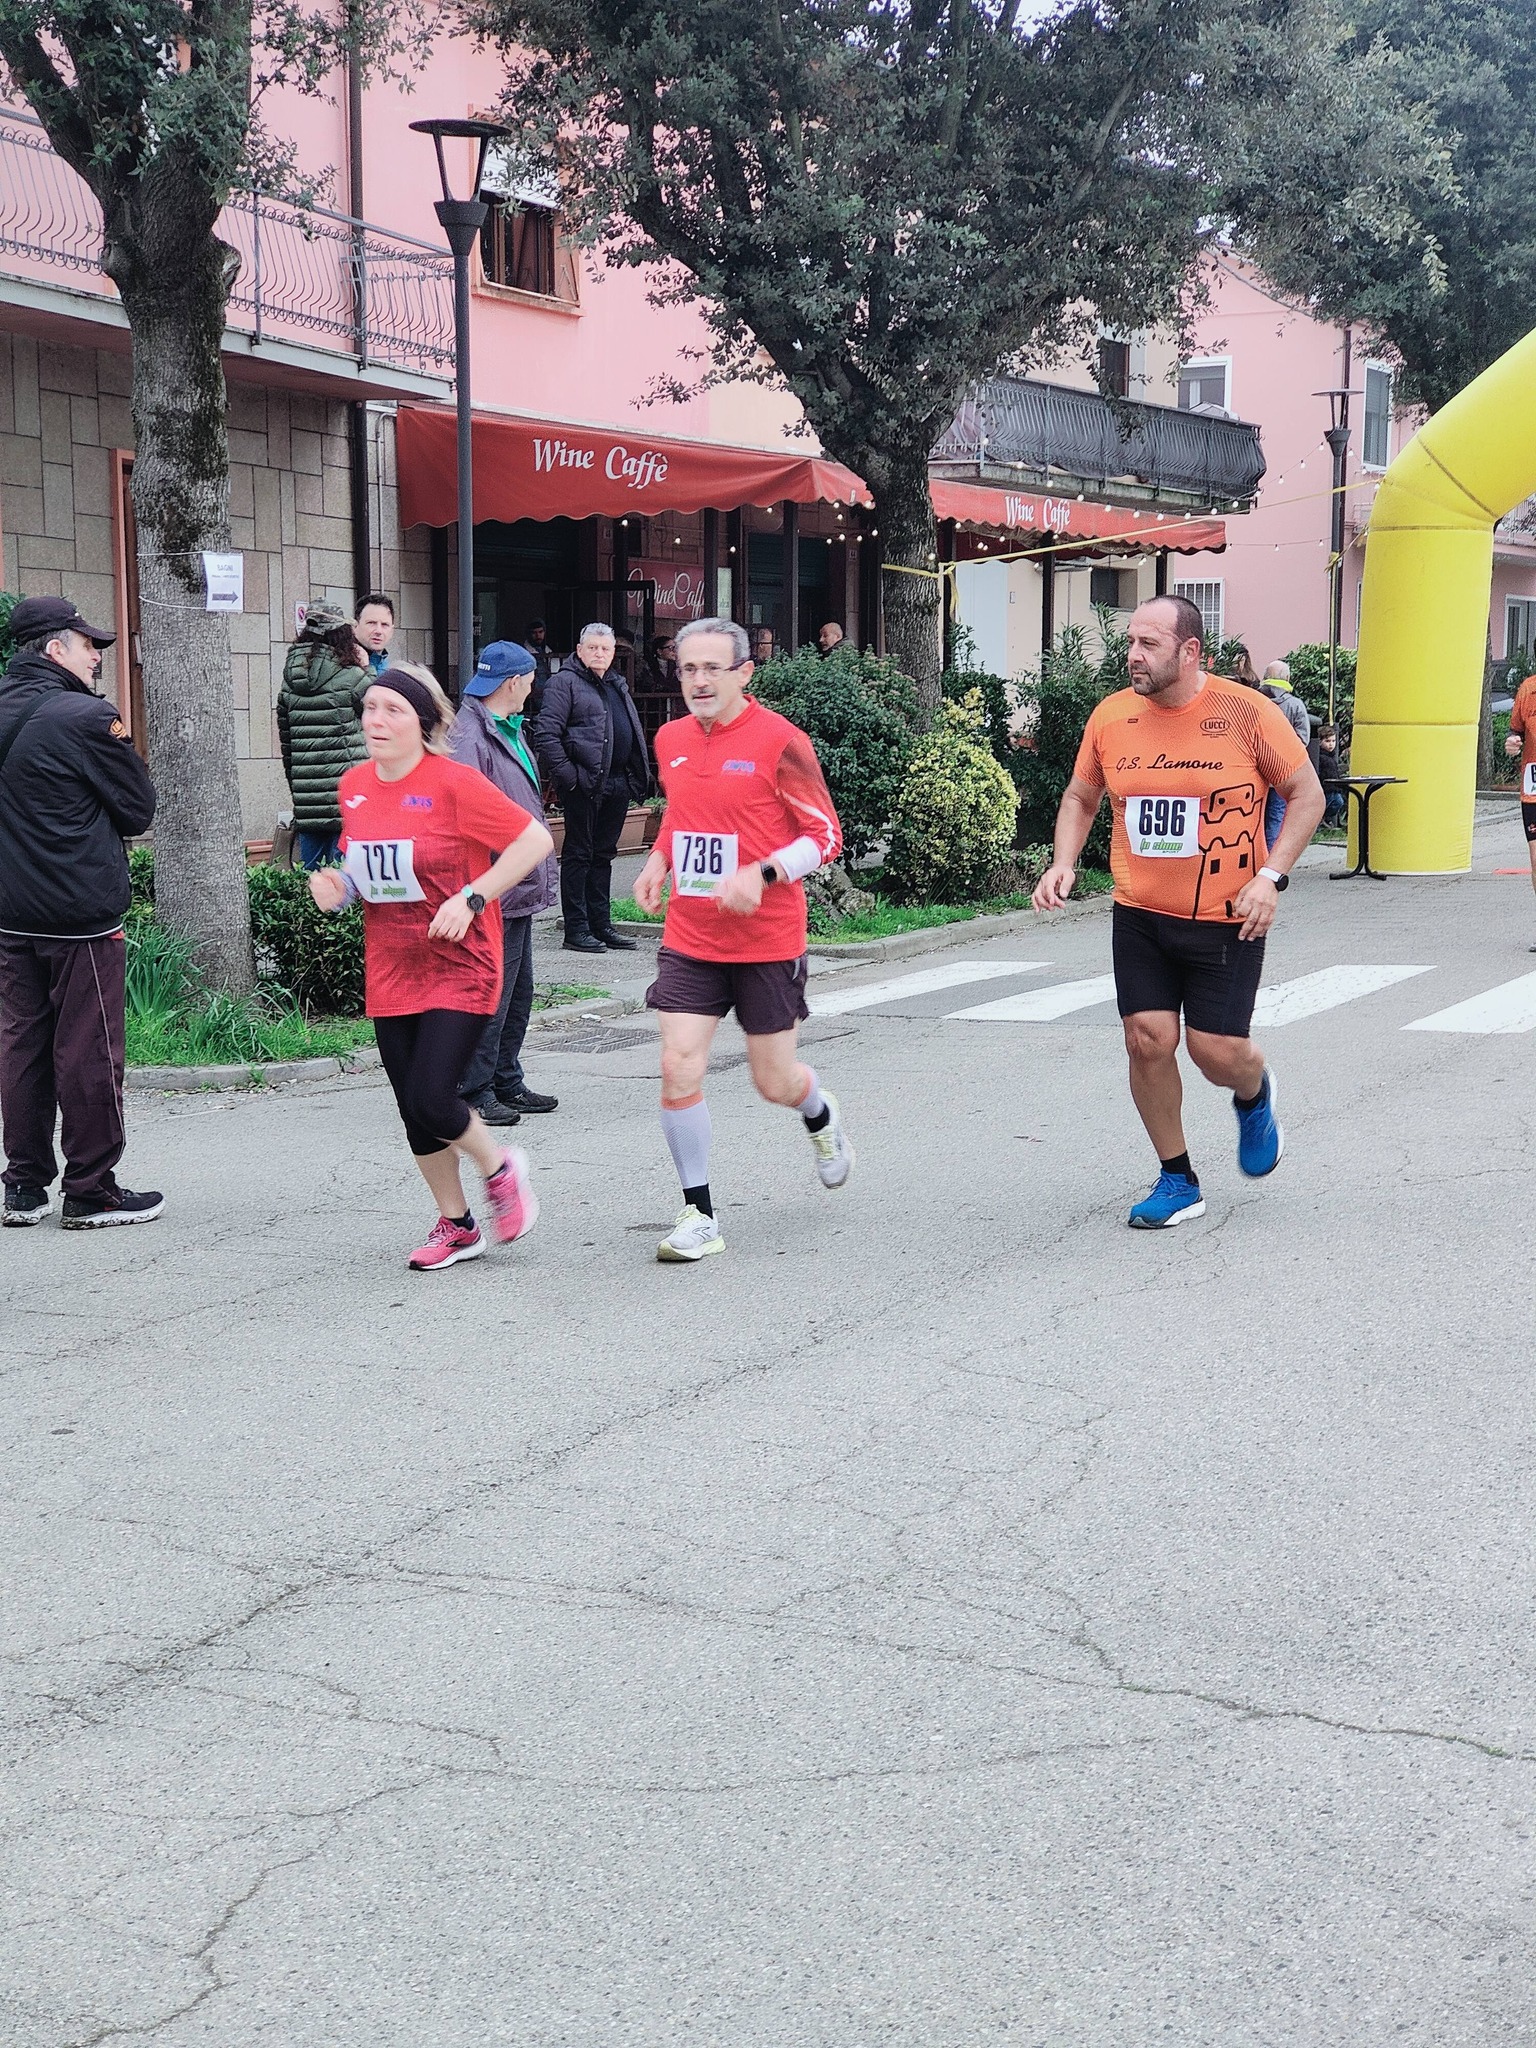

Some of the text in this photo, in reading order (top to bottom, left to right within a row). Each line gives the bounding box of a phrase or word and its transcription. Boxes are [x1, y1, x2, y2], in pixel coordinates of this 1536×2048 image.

[533, 438, 669, 490] Wine Caffè
[1005, 496, 1071, 535] Wine Caffè
[1204, 721, 1227, 730] LUCCI
[1147, 753, 1224, 771] Lamone
[1138, 799, 1187, 836] 696
[681, 835, 723, 875] 736
